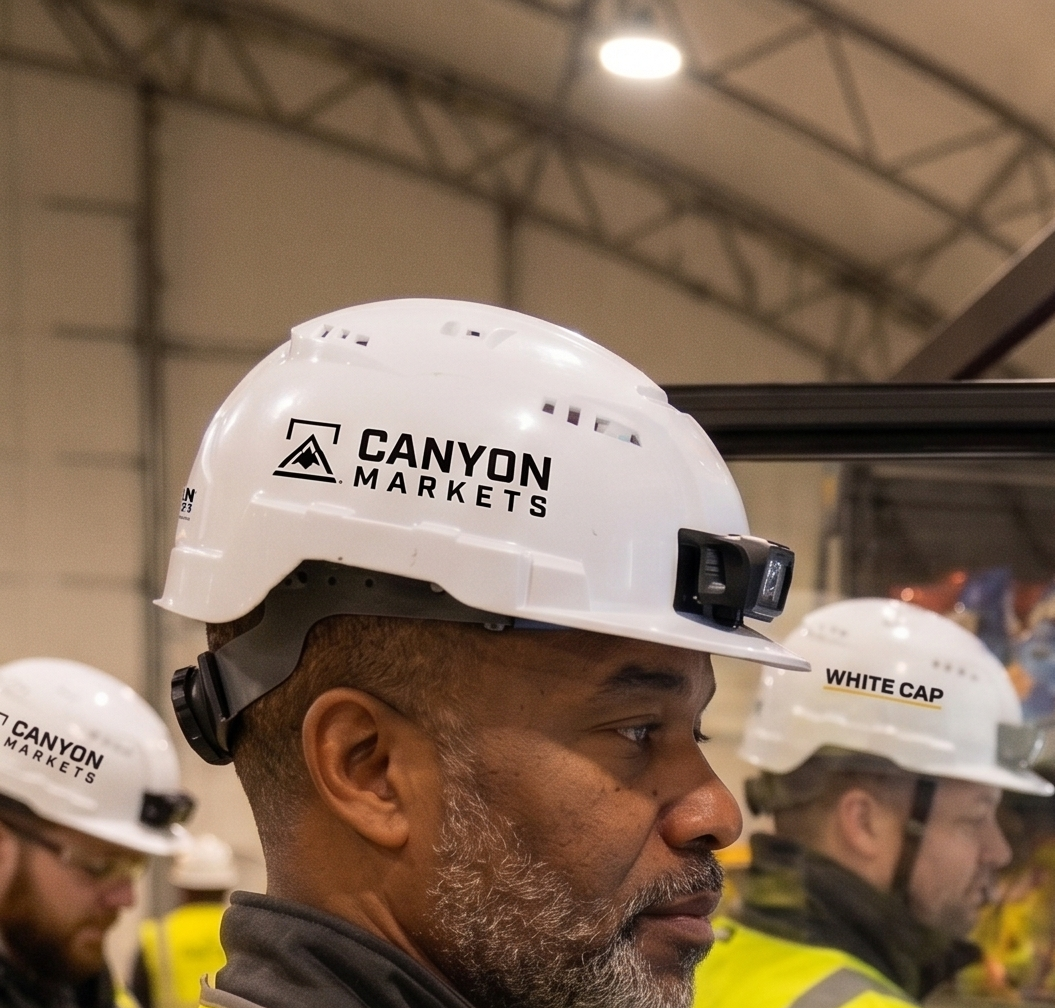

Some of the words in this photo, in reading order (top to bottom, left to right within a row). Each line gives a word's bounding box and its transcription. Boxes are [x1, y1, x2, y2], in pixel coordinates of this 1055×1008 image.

[358, 428, 552, 491] CANYON
[353, 466, 547, 518] MARKETS
[826, 668, 895, 695] WHITE
[899, 682, 944, 703] CAP
[4, 736, 96, 784] MARKETS
[11, 720, 104, 770] CANYON
